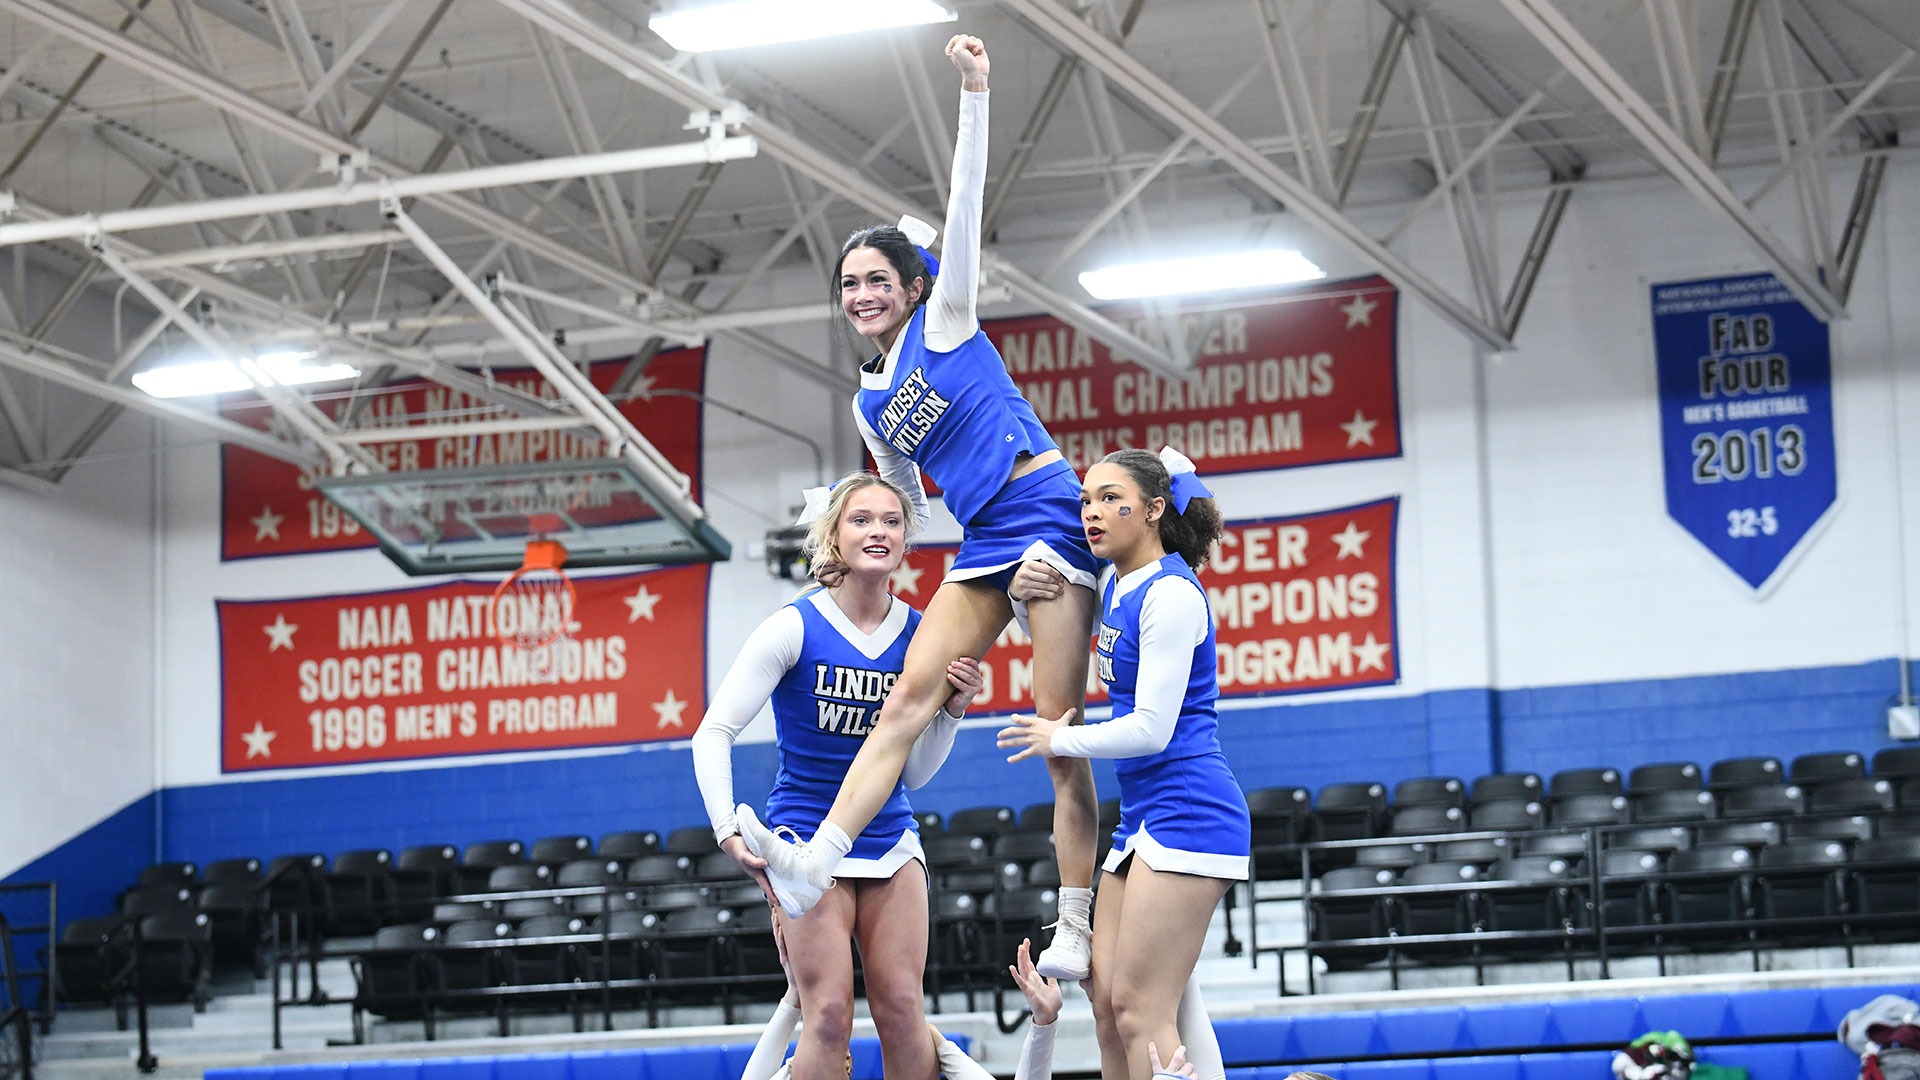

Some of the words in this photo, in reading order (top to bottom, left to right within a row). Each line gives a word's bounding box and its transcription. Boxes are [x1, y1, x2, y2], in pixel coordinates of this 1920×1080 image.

[1002, 327, 1094, 375] NAIA
[1708, 312, 1774, 355] FAB
[878, 365, 930, 440] LINDSEY
[1113, 352, 1334, 416] CHAMPIONS
[1699, 353, 1790, 399] FOUR
[892, 388, 951, 457] WILSON
[1055, 427, 1134, 468] EN'S
[1146, 411, 1303, 461] PROGRAM
[1683, 403, 1725, 425] MEN'S
[437, 428, 606, 470] CHAMPION
[1692, 424, 1807, 484] 2013
[308, 495, 363, 540] 199
[1727, 505, 1779, 538] 32-5
[1198, 524, 1309, 575] CER
[338, 603, 413, 650] NAIA
[427, 590, 582, 642] NATIONAL
[1206, 572, 1379, 629] MPIONS
[299, 653, 423, 703] SOCCER
[437, 636, 627, 692] CHAMPIONS
[814, 664, 902, 702] LINDS
[1214, 632, 1353, 687] OGRAM
[308, 705, 386, 752] 1996
[395, 702, 477, 742] MEN'S
[489, 692, 618, 733] PROGRAM
[817, 699, 881, 736] WILS
